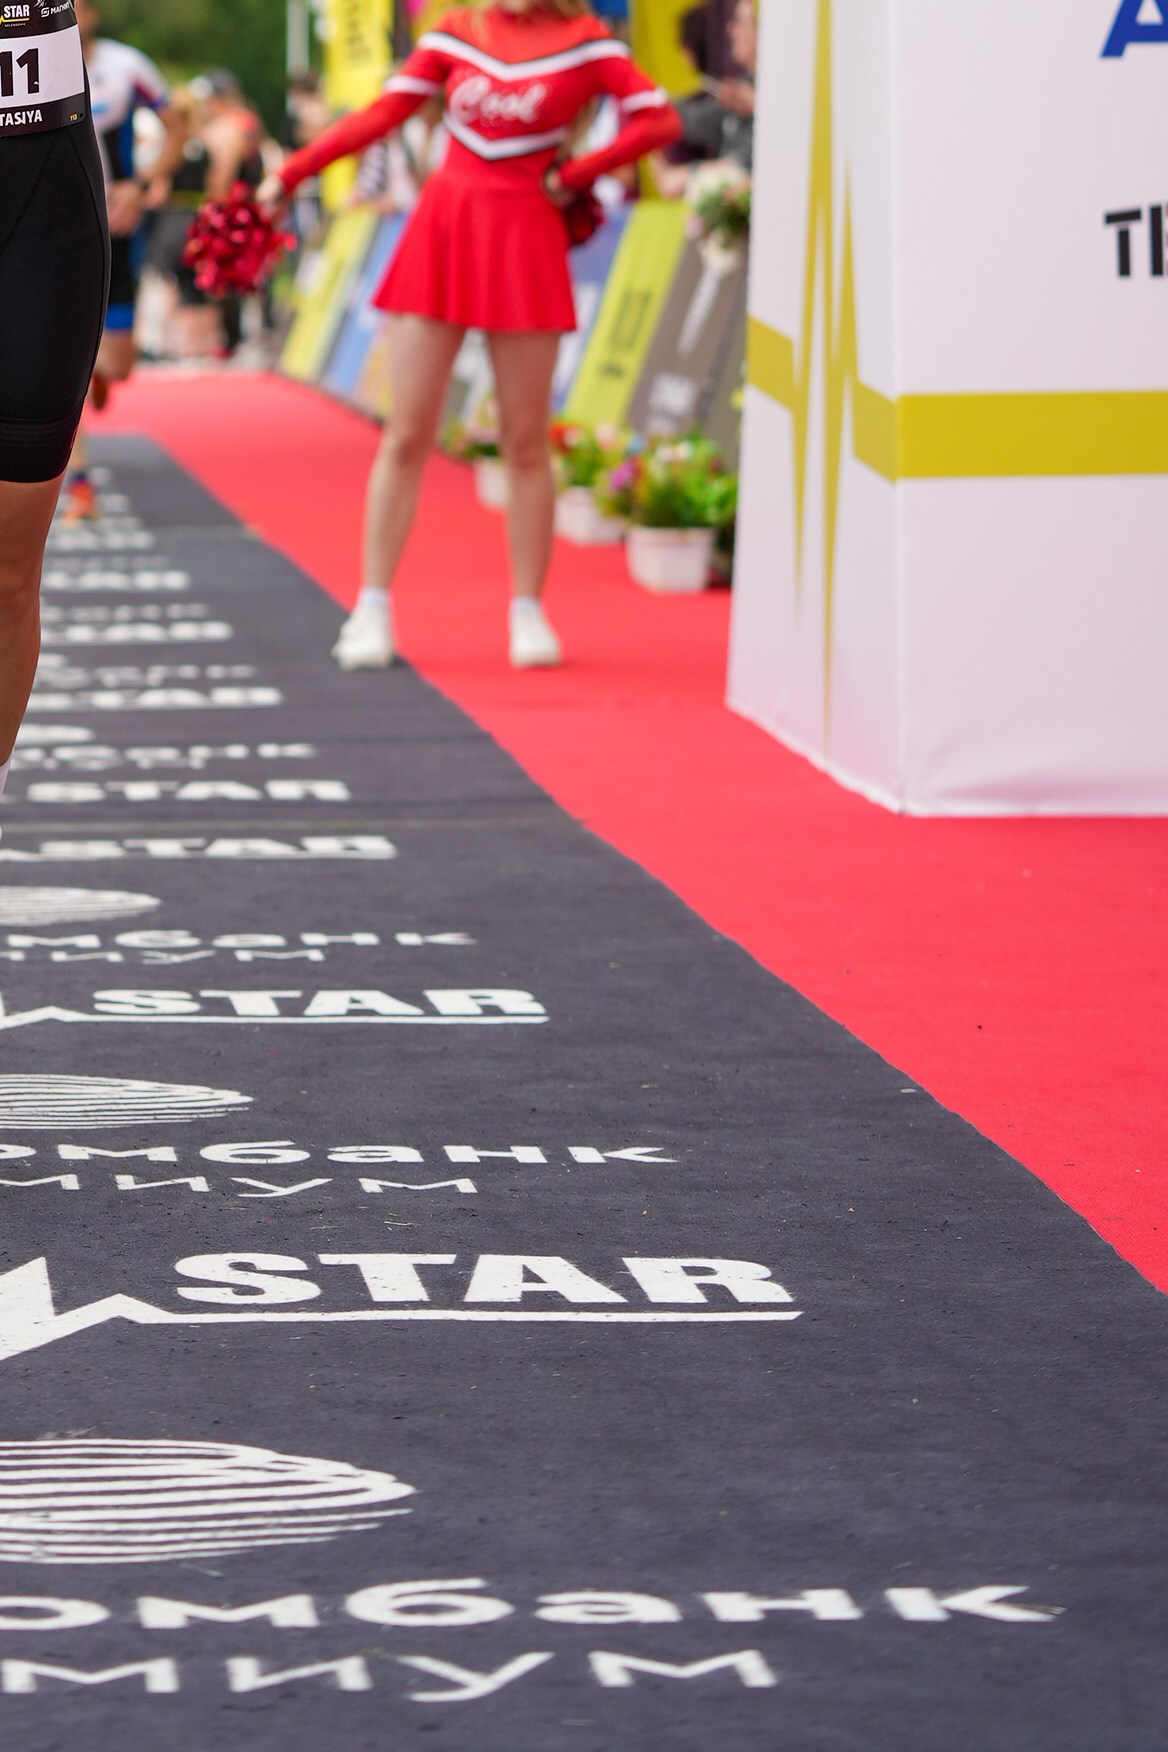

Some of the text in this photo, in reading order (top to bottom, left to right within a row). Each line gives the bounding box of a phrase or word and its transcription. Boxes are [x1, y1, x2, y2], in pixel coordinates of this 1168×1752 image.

[3, 4, 30, 19] STAR
[92, 988, 548, 1016] STAR
[175, 1250, 798, 1305] STAR
